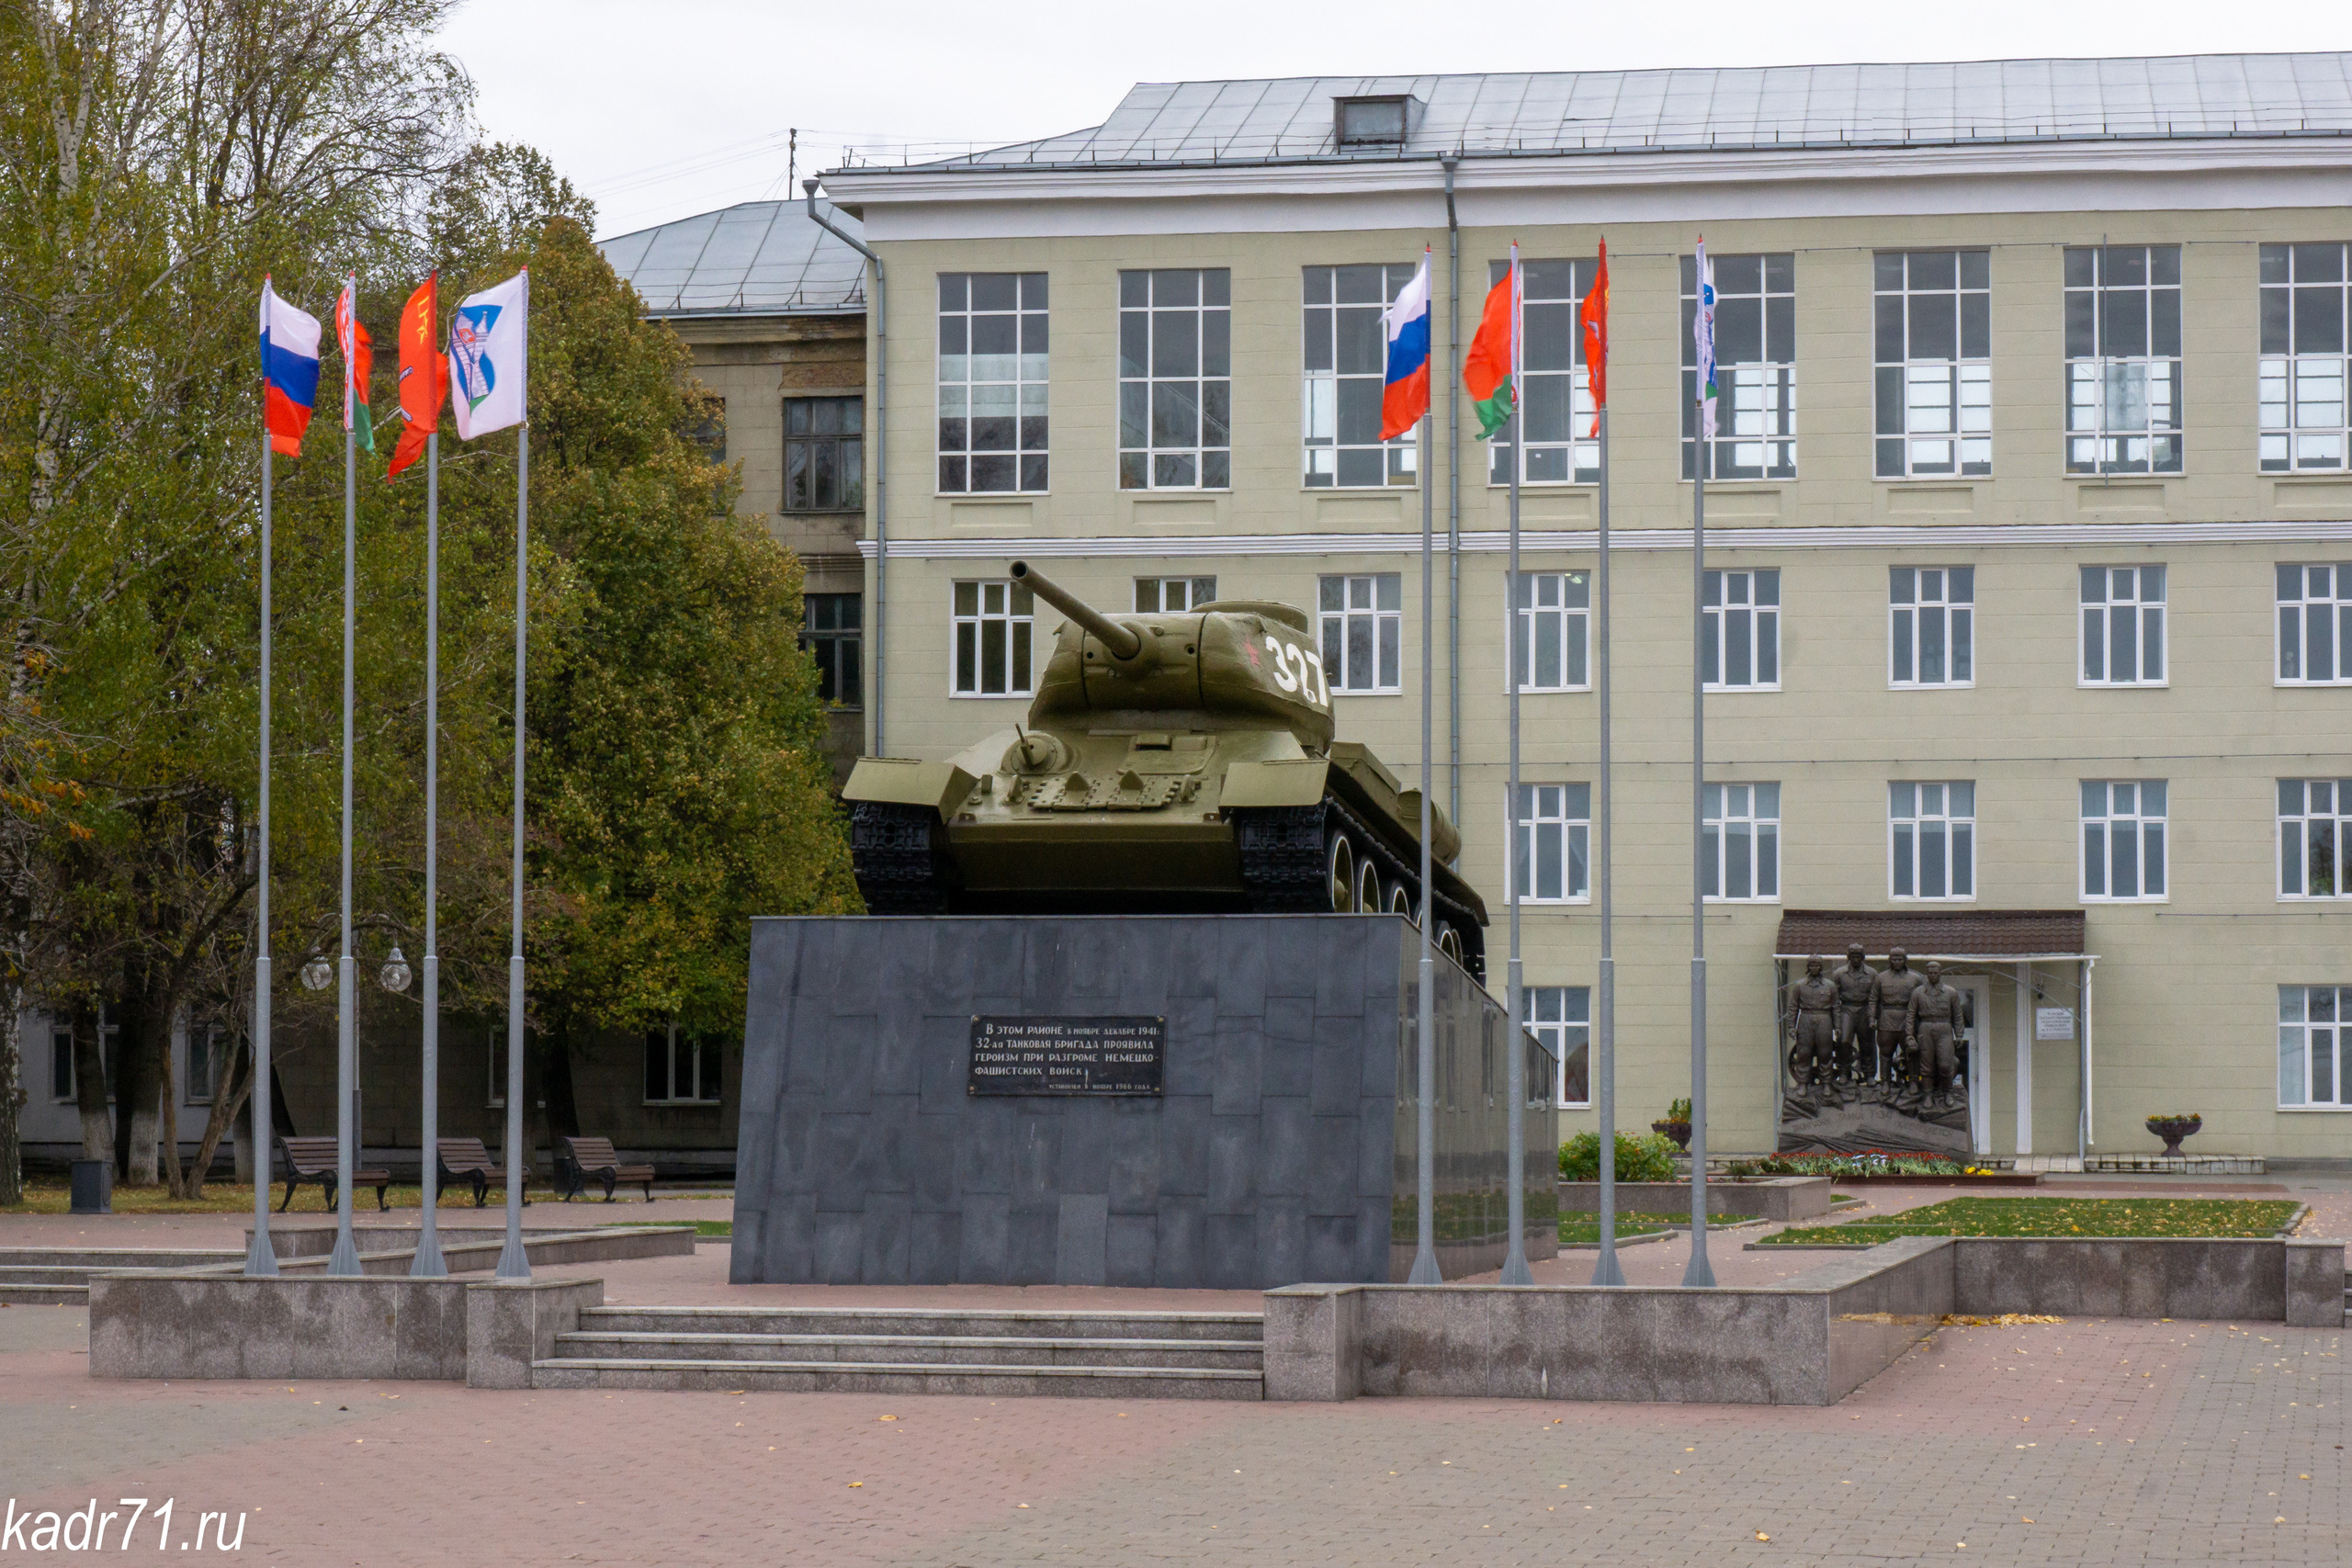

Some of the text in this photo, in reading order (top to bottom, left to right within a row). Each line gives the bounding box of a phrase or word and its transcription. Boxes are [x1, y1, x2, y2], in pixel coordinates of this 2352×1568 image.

[1265, 636, 1329, 707] 327
[986, 1023, 993, 1034] В
[997, 1026, 1023, 1034] ЭТОМ
[1027, 1024, 1063, 1034] РАЙОНЕ
[1006, 1039, 1051, 1048] ТАНКОВАЯ
[1055, 1040, 1099, 1049] БРИГАДА
[1103, 1040, 1154, 1049] ПРОЯВИЛА
[975, 1053, 1159, 1063] ГЕРОИЗМ ПРИ РАЗГРОМЕ НЕМЕЦКО-
[975, 1066, 1043, 1075] ФАШИСТСКИХ
